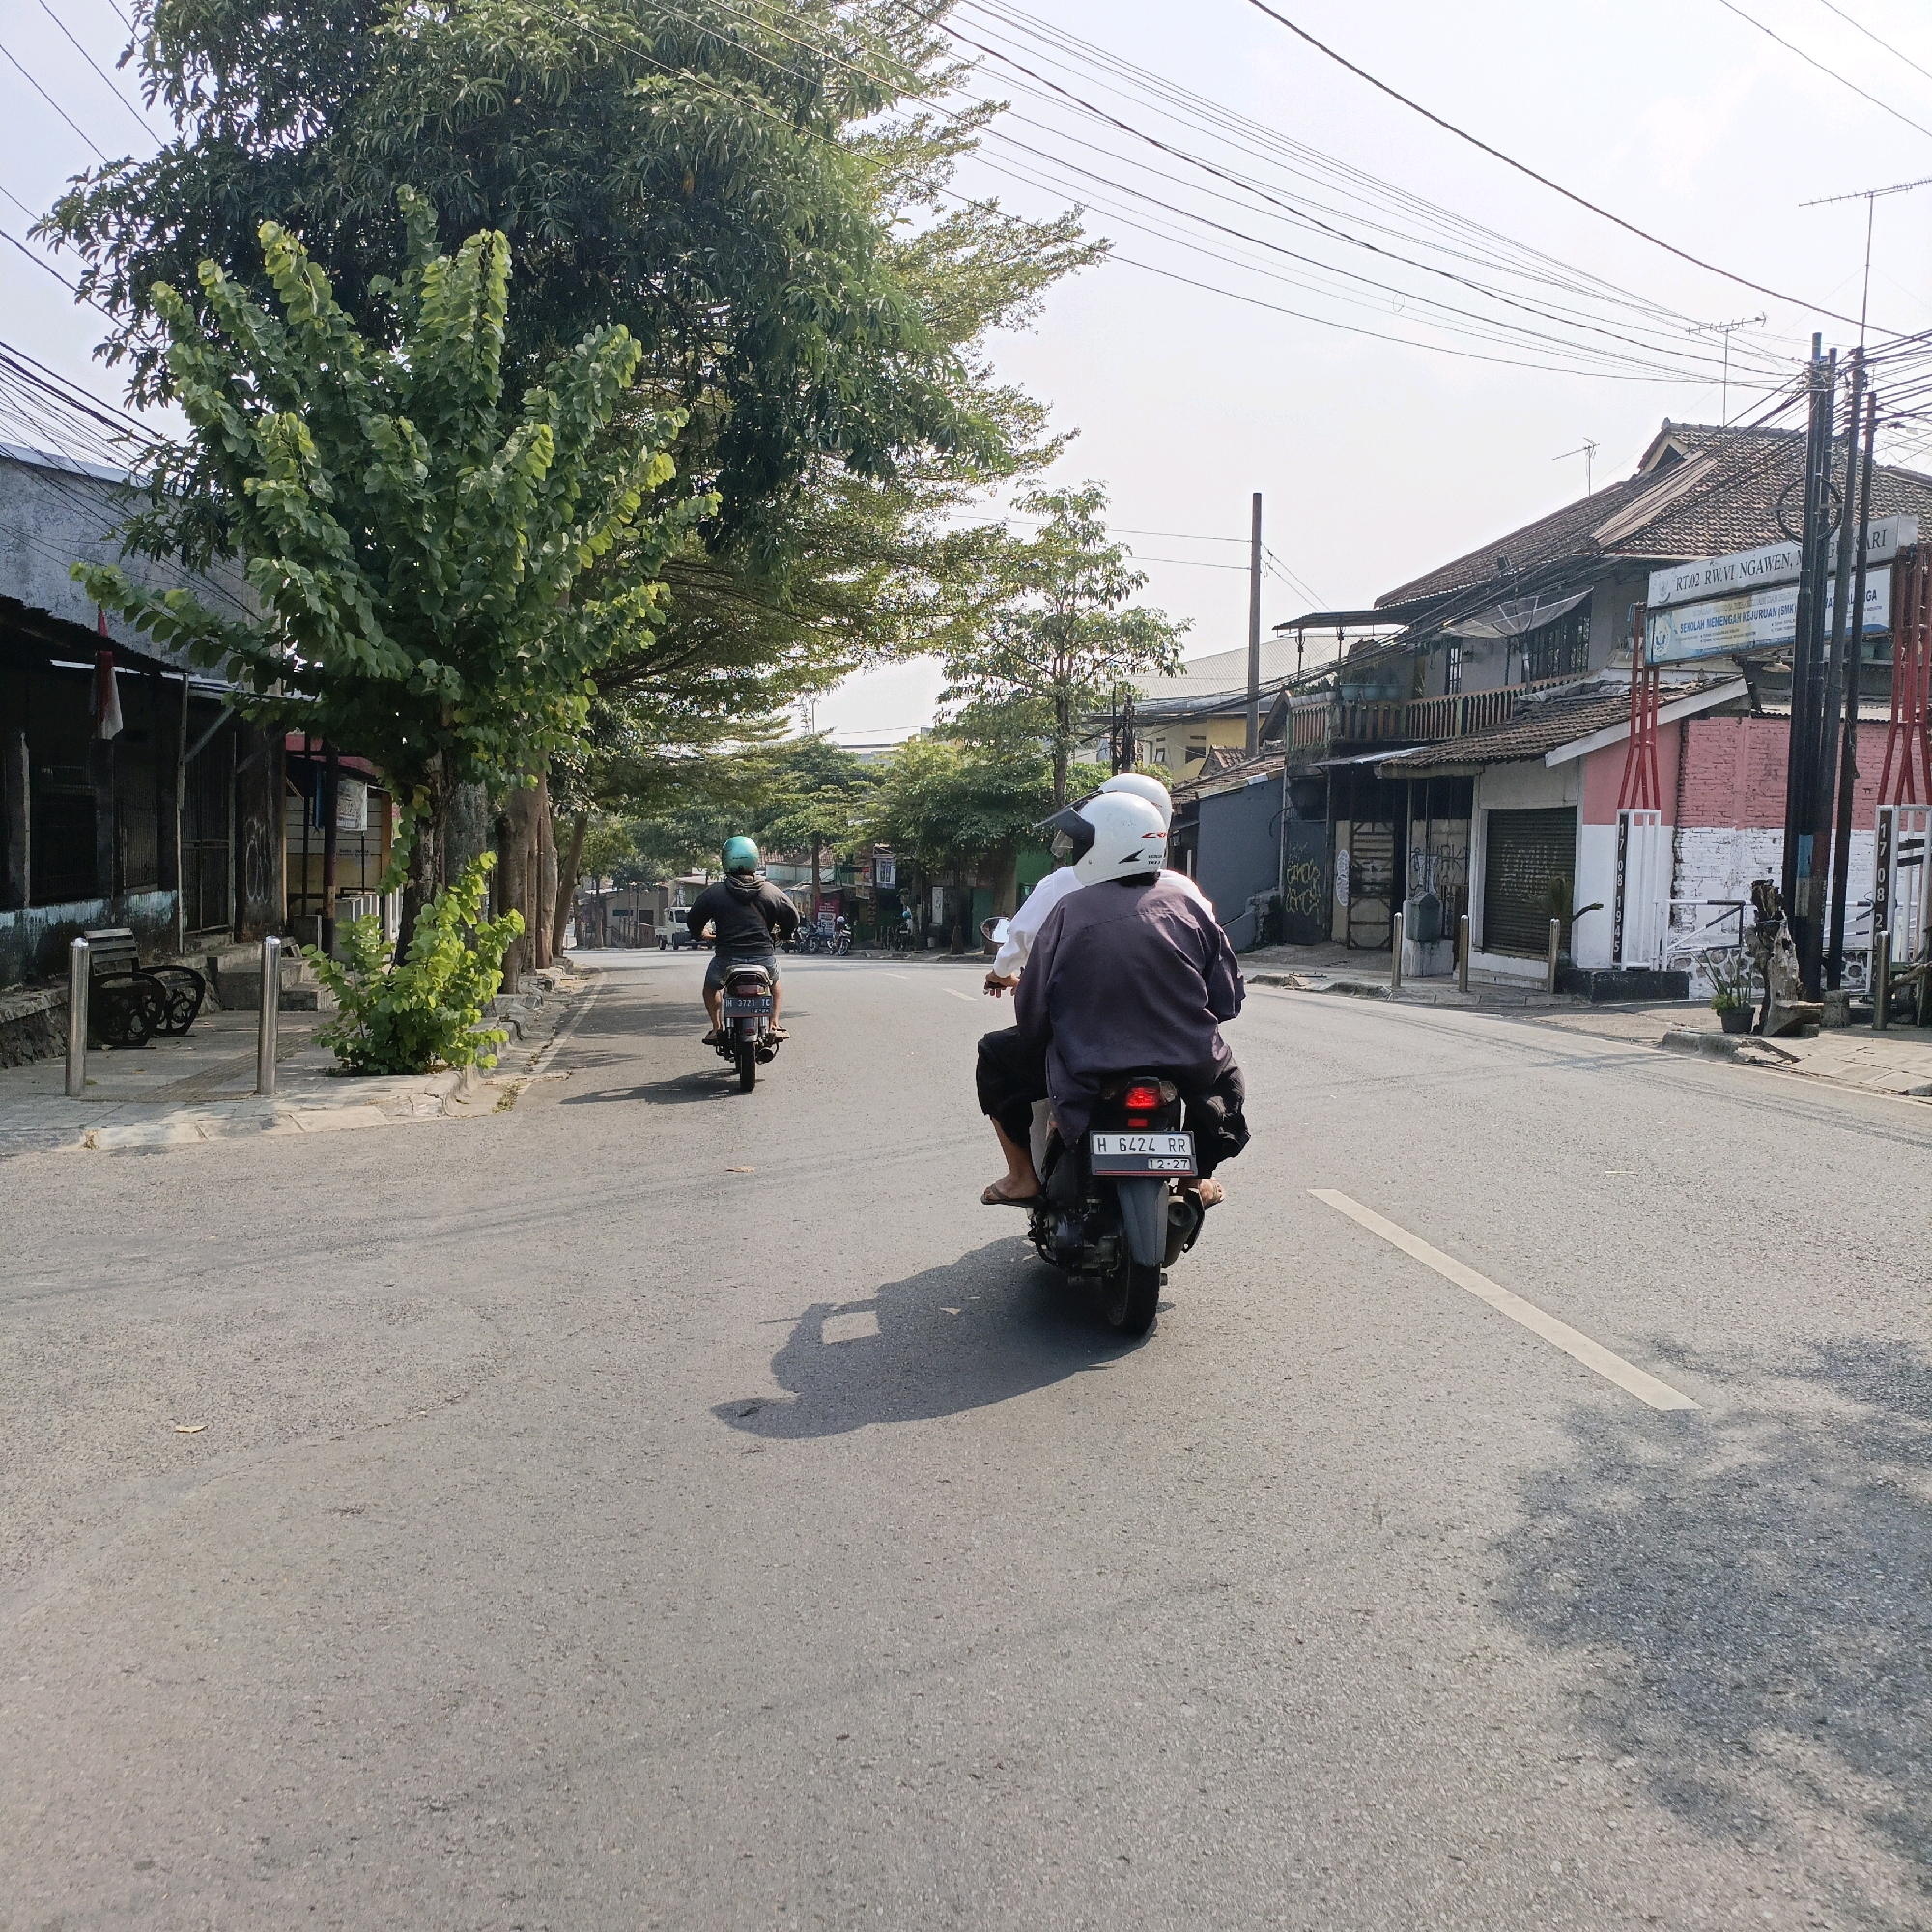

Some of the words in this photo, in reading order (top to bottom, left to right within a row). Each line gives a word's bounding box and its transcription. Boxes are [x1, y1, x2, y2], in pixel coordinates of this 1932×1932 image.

[1675, 574, 1700, 591] RT.02
[1680, 619, 1705, 634] SEKOLAH
[1706, 612, 1742, 629] MENENGAH
[1742, 606, 1777, 623] KEJURUAN
[1613, 895, 1622, 953] 1945
[1097, 1137, 1107, 1152] H
[1119, 1137, 1156, 1152] 6424
[1168, 1137, 1186, 1153] RR
